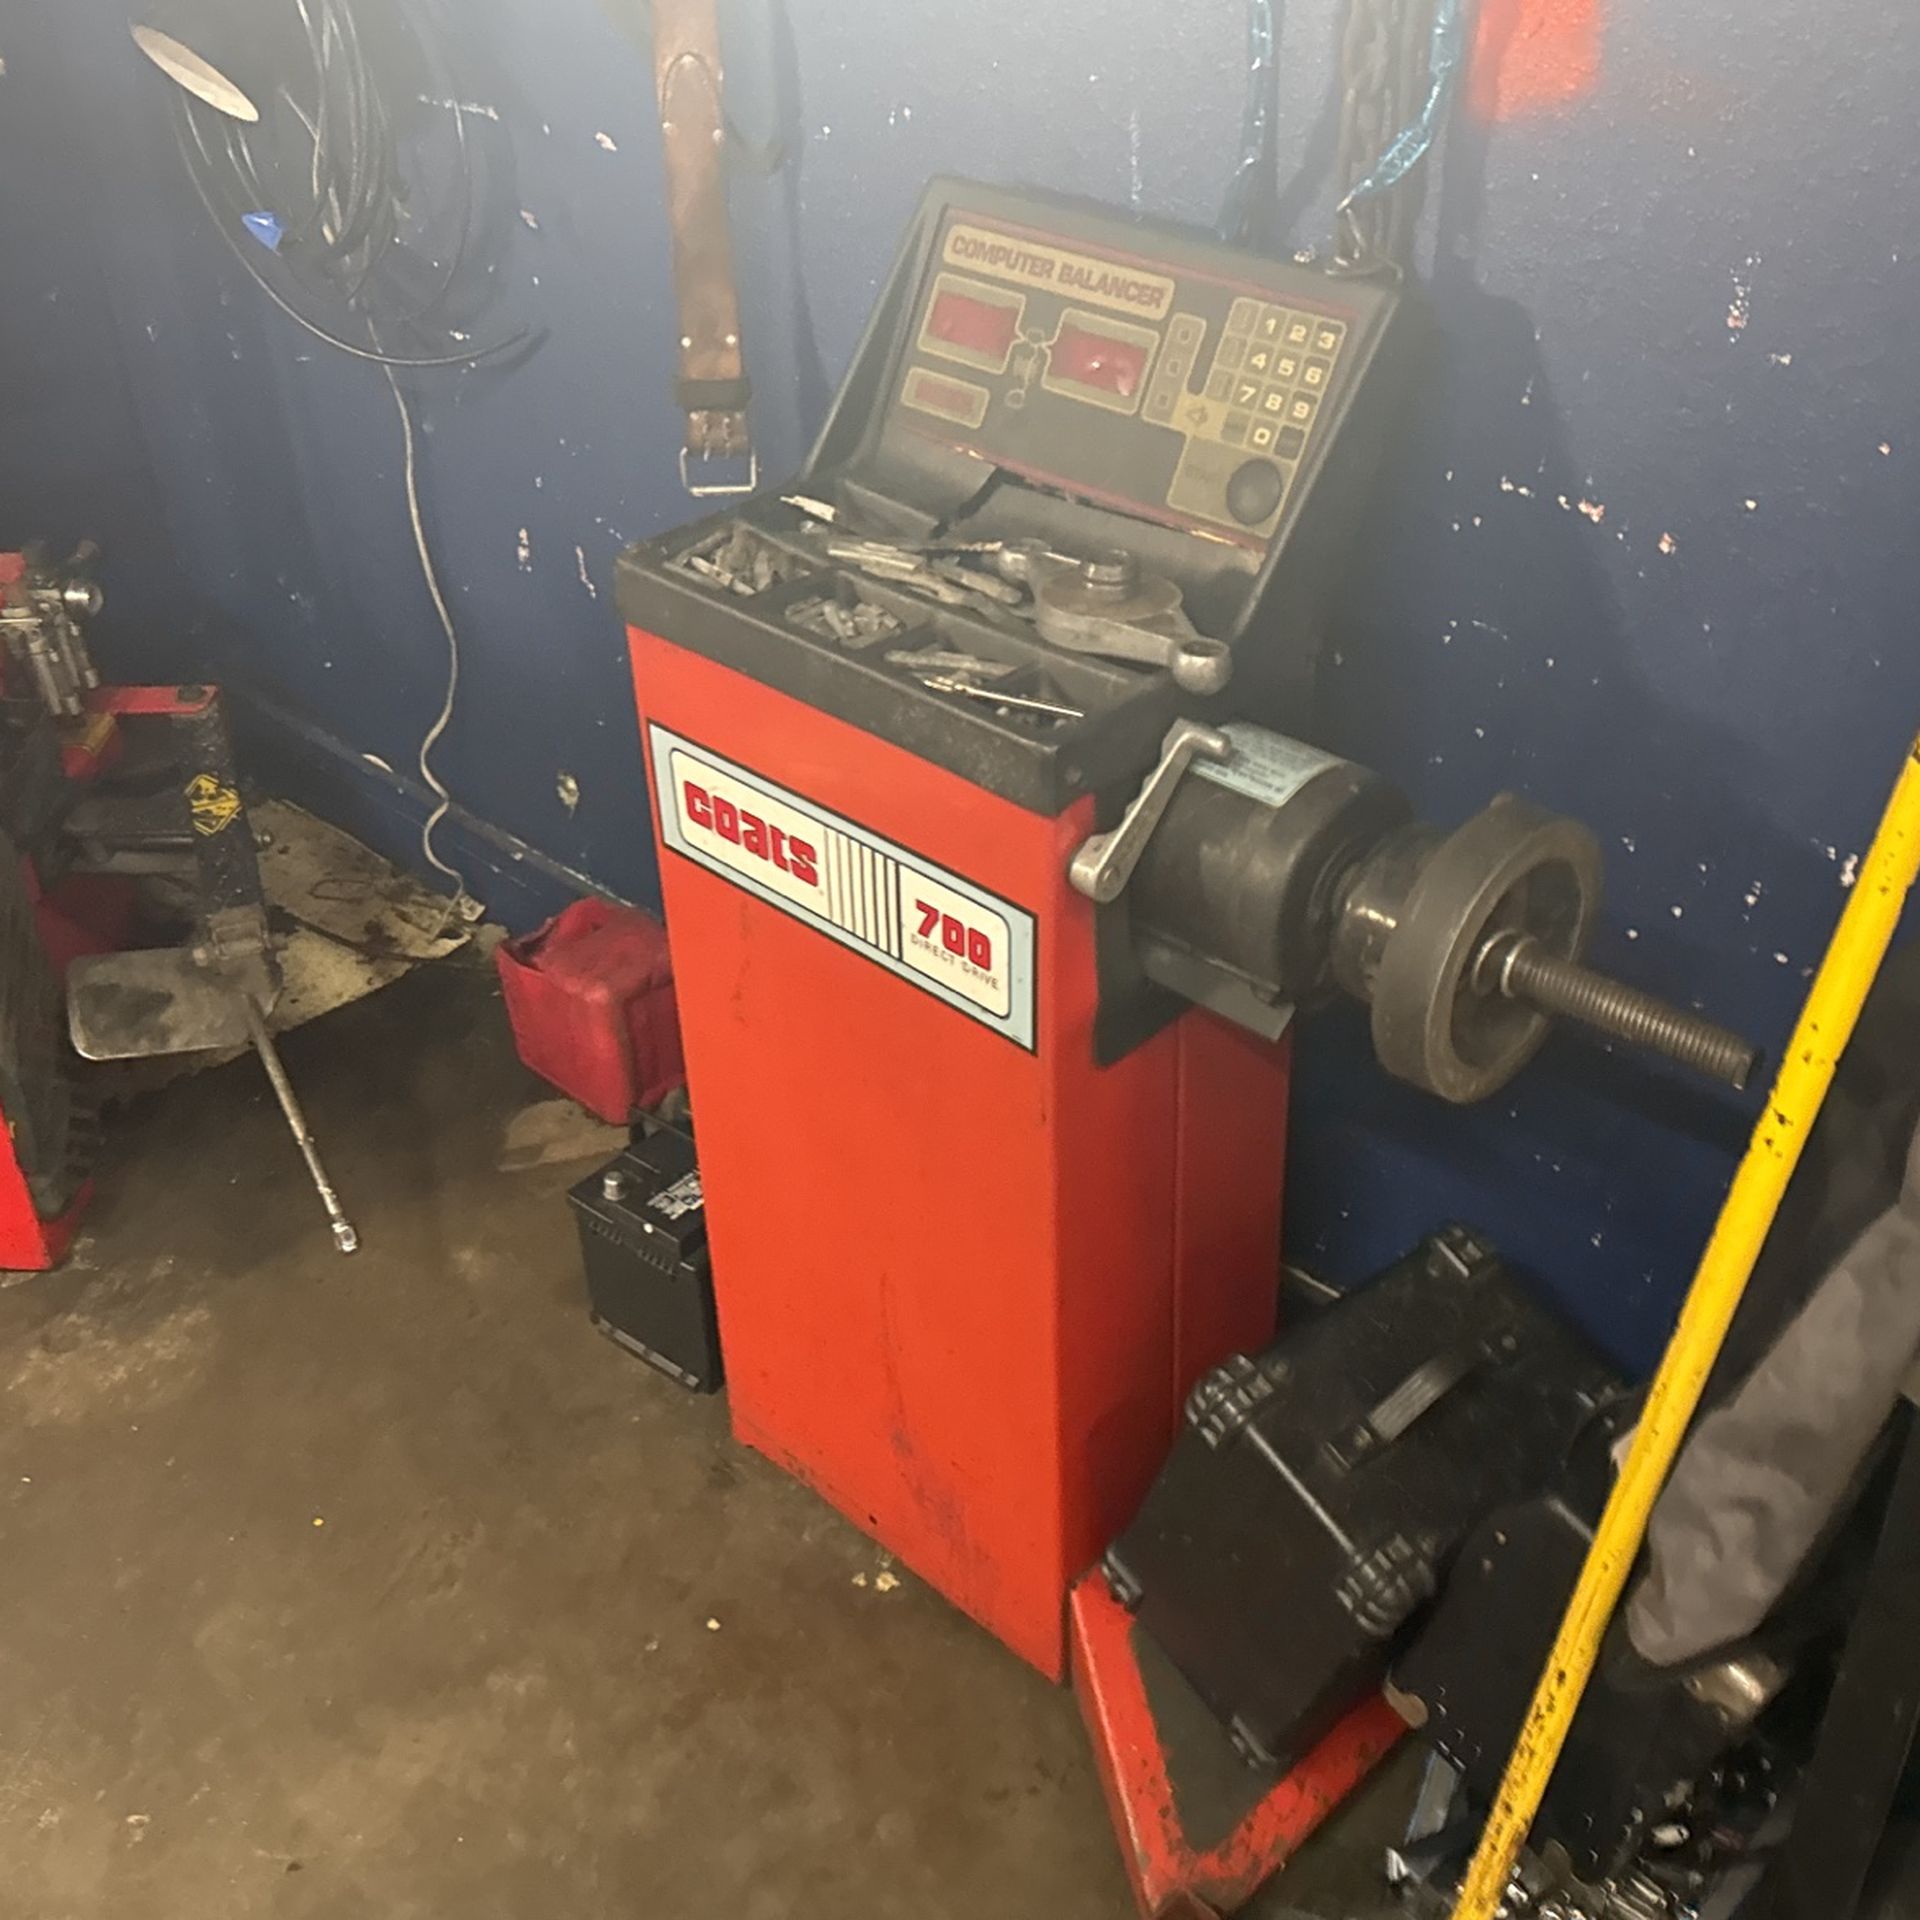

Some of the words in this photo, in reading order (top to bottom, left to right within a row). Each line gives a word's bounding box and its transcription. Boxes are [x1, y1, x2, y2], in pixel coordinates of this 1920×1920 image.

[951, 235, 1055, 280] COMPUTER
[1057, 262, 1167, 309] BALANCER
[1265, 318, 1277, 334] 1
[1289, 324, 1306, 342] 2
[1317, 331, 1335, 349] 3
[1251, 353, 1267, 370] 4
[1278, 358, 1295, 377] 5
[1305, 366, 1322, 384] 6
[1240, 384, 1256, 402] 7
[1265, 393, 1282, 411] 8
[1293, 401, 1309, 419] 9
[1253, 427, 1271, 445] 0
[915, 898, 991, 972] 700
[910, 933, 955, 965] DIRECT
[961, 961, 999, 990] DRIVE
